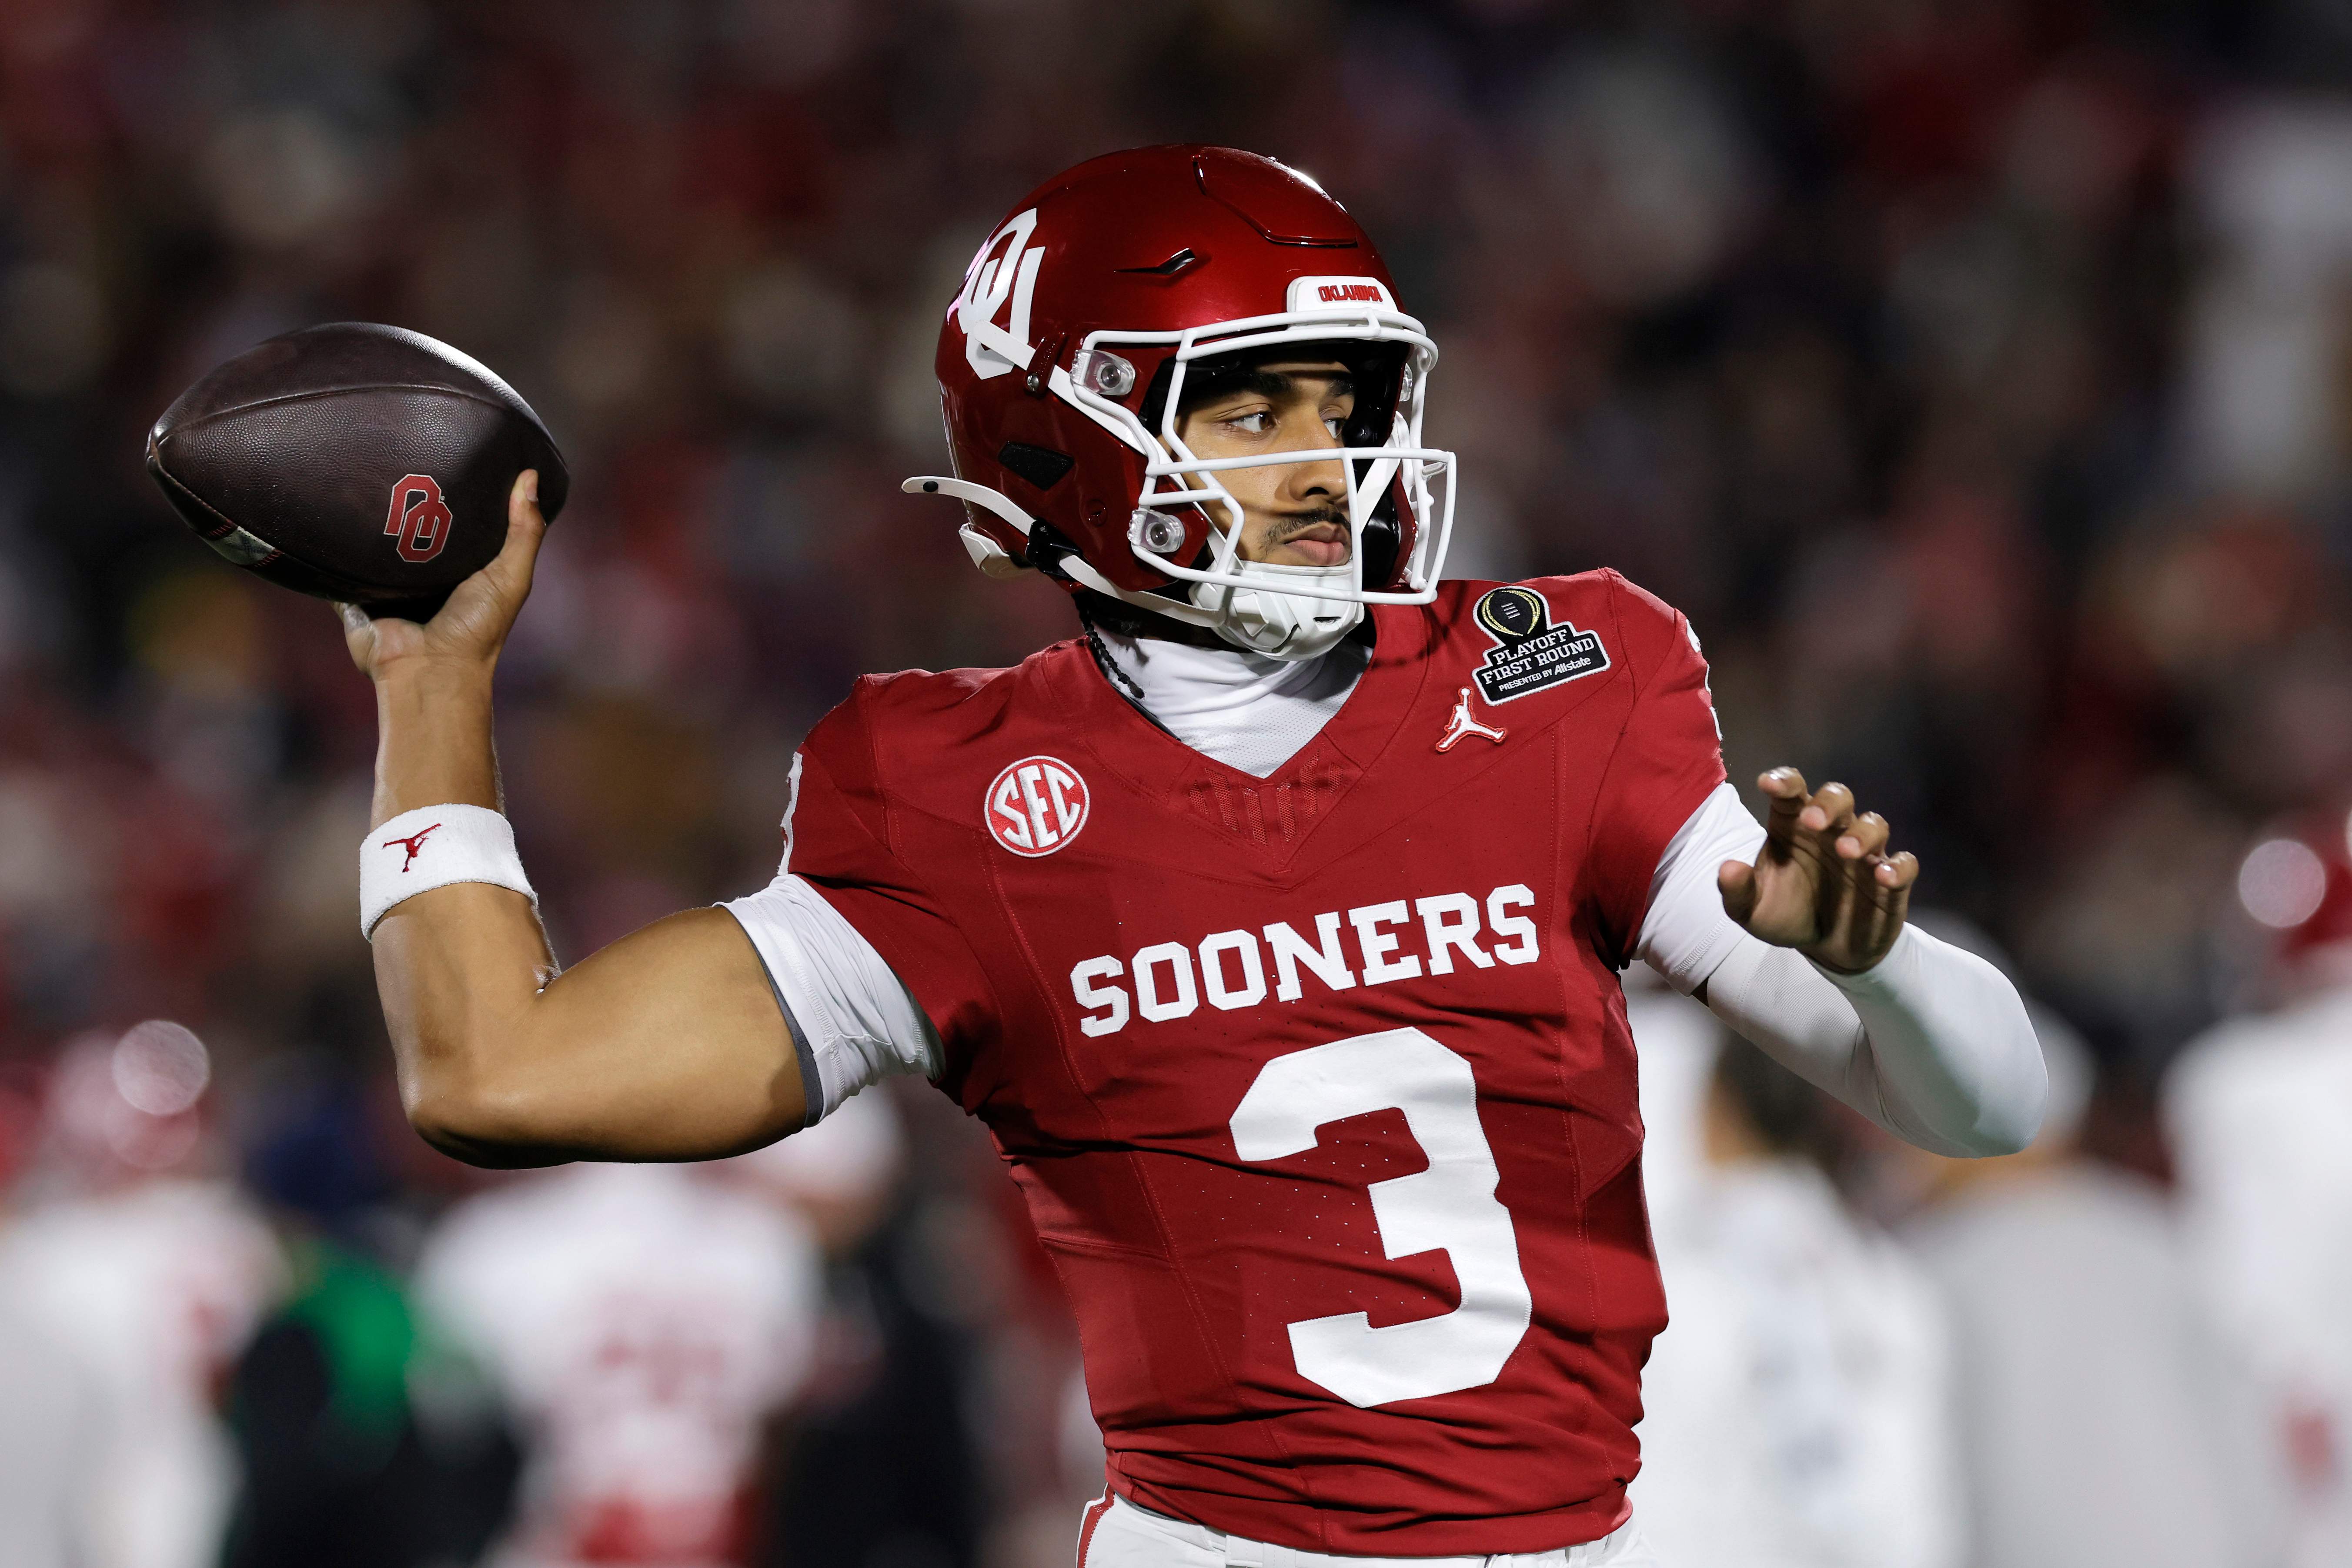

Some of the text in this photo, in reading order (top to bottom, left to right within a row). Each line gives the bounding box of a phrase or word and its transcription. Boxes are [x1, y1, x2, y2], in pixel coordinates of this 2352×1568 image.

[1481, 638, 1594, 685] FIRST ROUND
[1493, 629, 1567, 665] PLAYOFF
[1498, 657, 1592, 692] PRESENTED BY Allstate
[994, 763, 1080, 849] SEC
[1070, 883, 1540, 1038] SOONERS
[1229, 1026, 1533, 1408] 3
